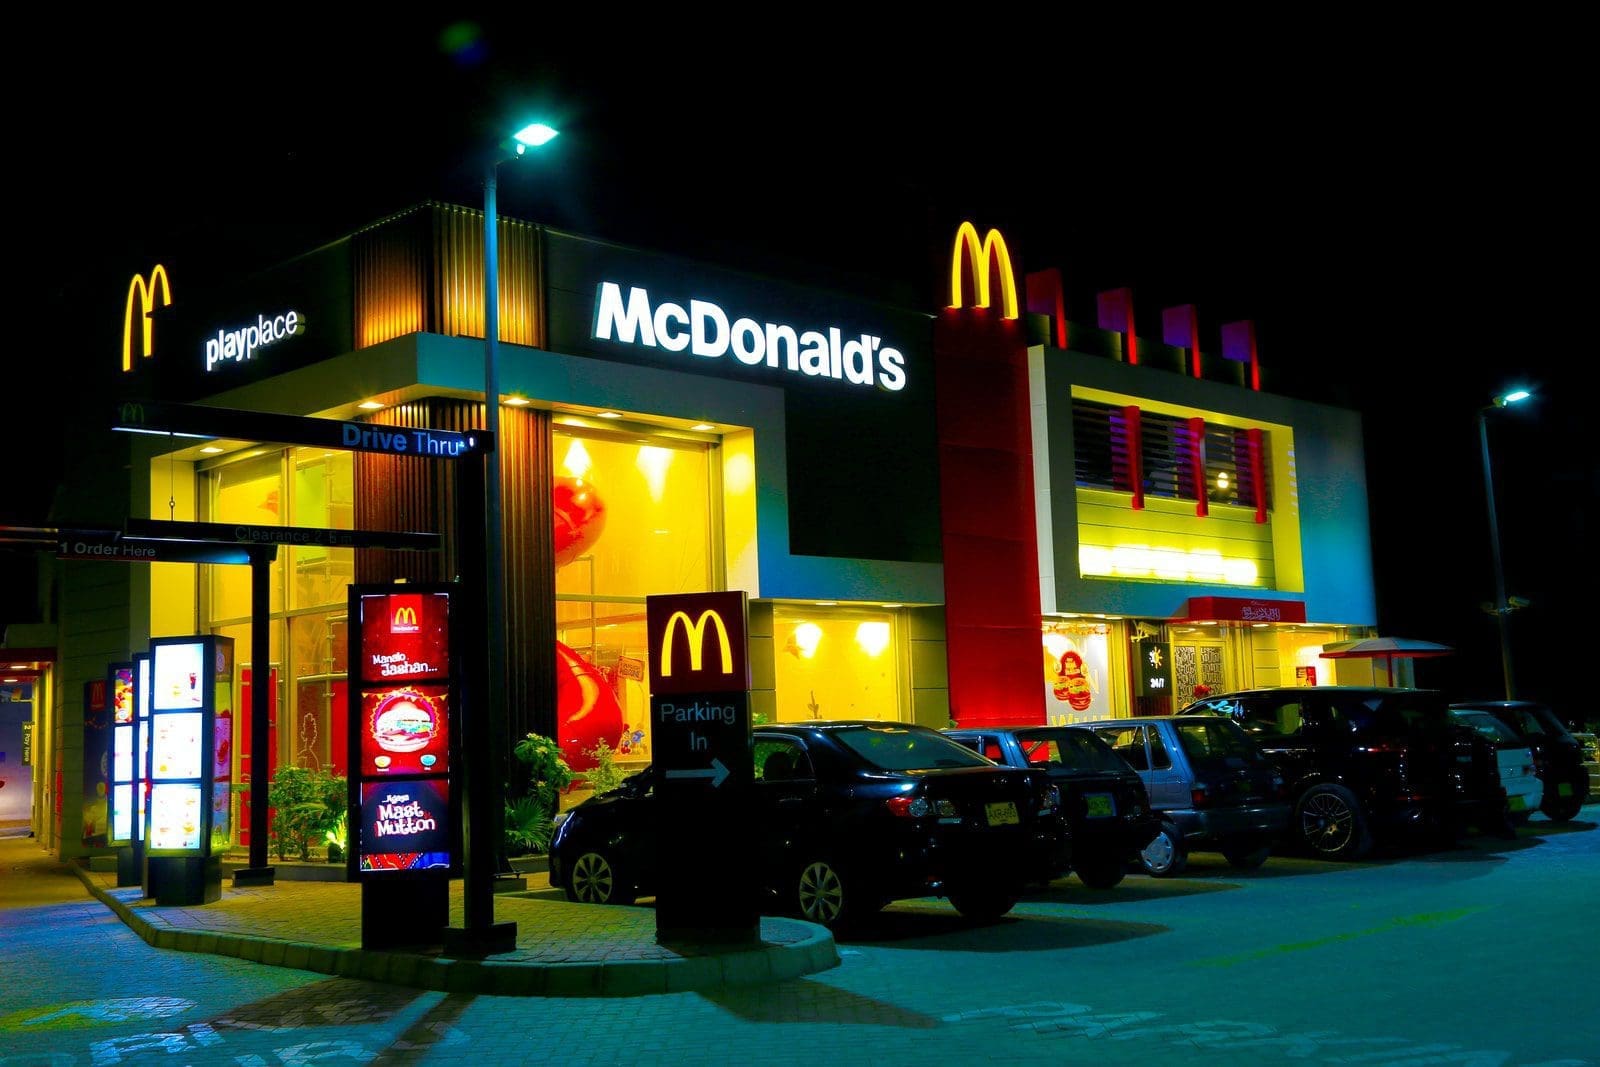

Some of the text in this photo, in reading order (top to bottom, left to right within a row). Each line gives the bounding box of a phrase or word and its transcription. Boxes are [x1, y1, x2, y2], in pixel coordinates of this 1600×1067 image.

[206, 310, 299, 372] playplace
[594, 280, 907, 393] McDonald's
[342, 423, 460, 457] Drive Thru
[235, 526, 311, 543] Clearance
[59, 541, 156, 557] 1 Order Here
[660, 701, 736, 725] Parking
[690, 730, 708, 751] In
[378, 801, 424, 821] Mast
[376, 817, 436, 837] Mutton
